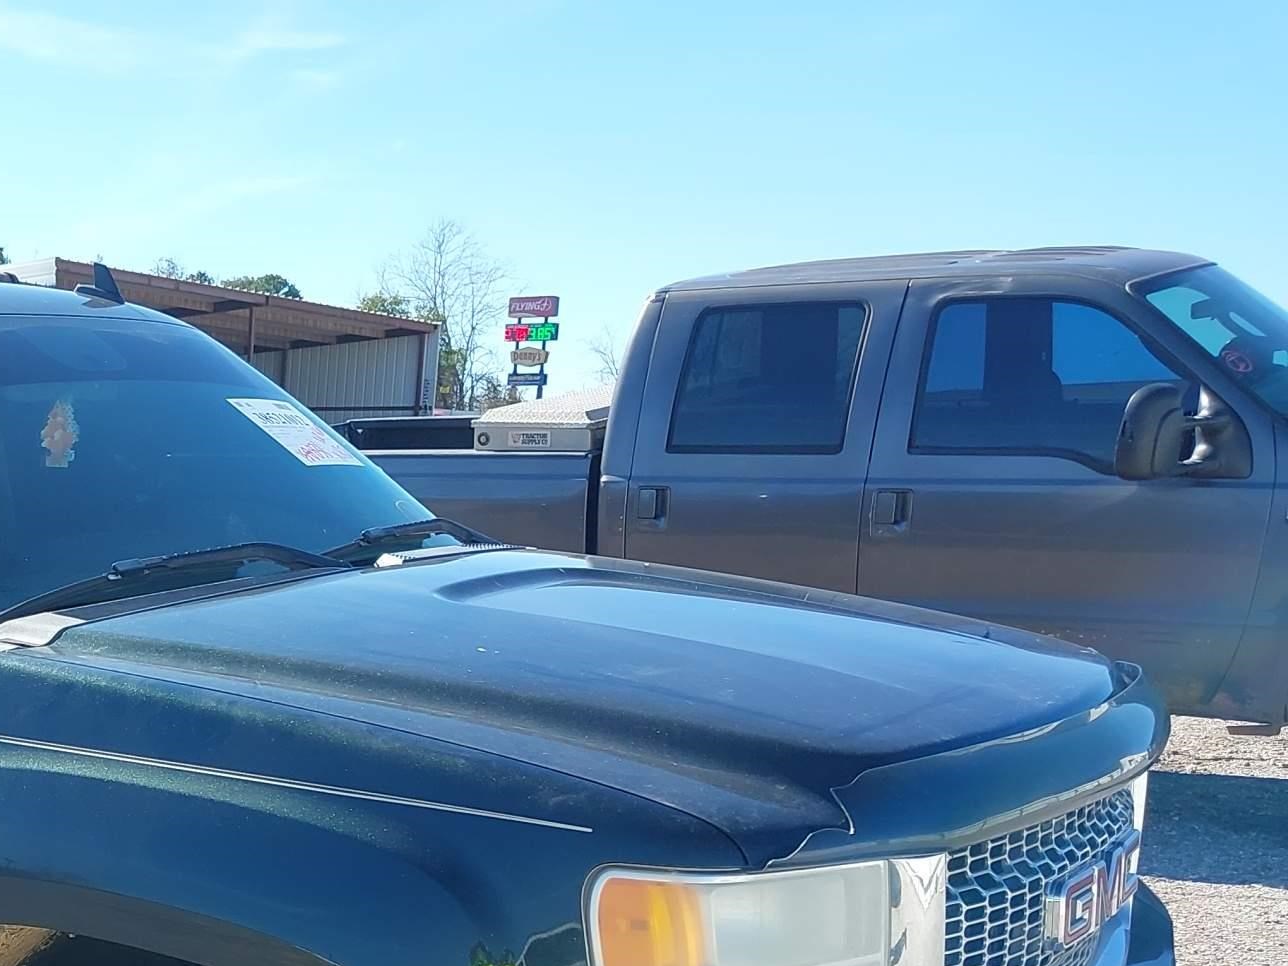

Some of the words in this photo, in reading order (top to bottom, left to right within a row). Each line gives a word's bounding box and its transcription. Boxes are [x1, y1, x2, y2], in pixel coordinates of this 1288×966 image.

[511, 301, 540, 311] FLYING
[513, 350, 542, 362] Denny's
[1059, 829, 1141, 949] GMC
